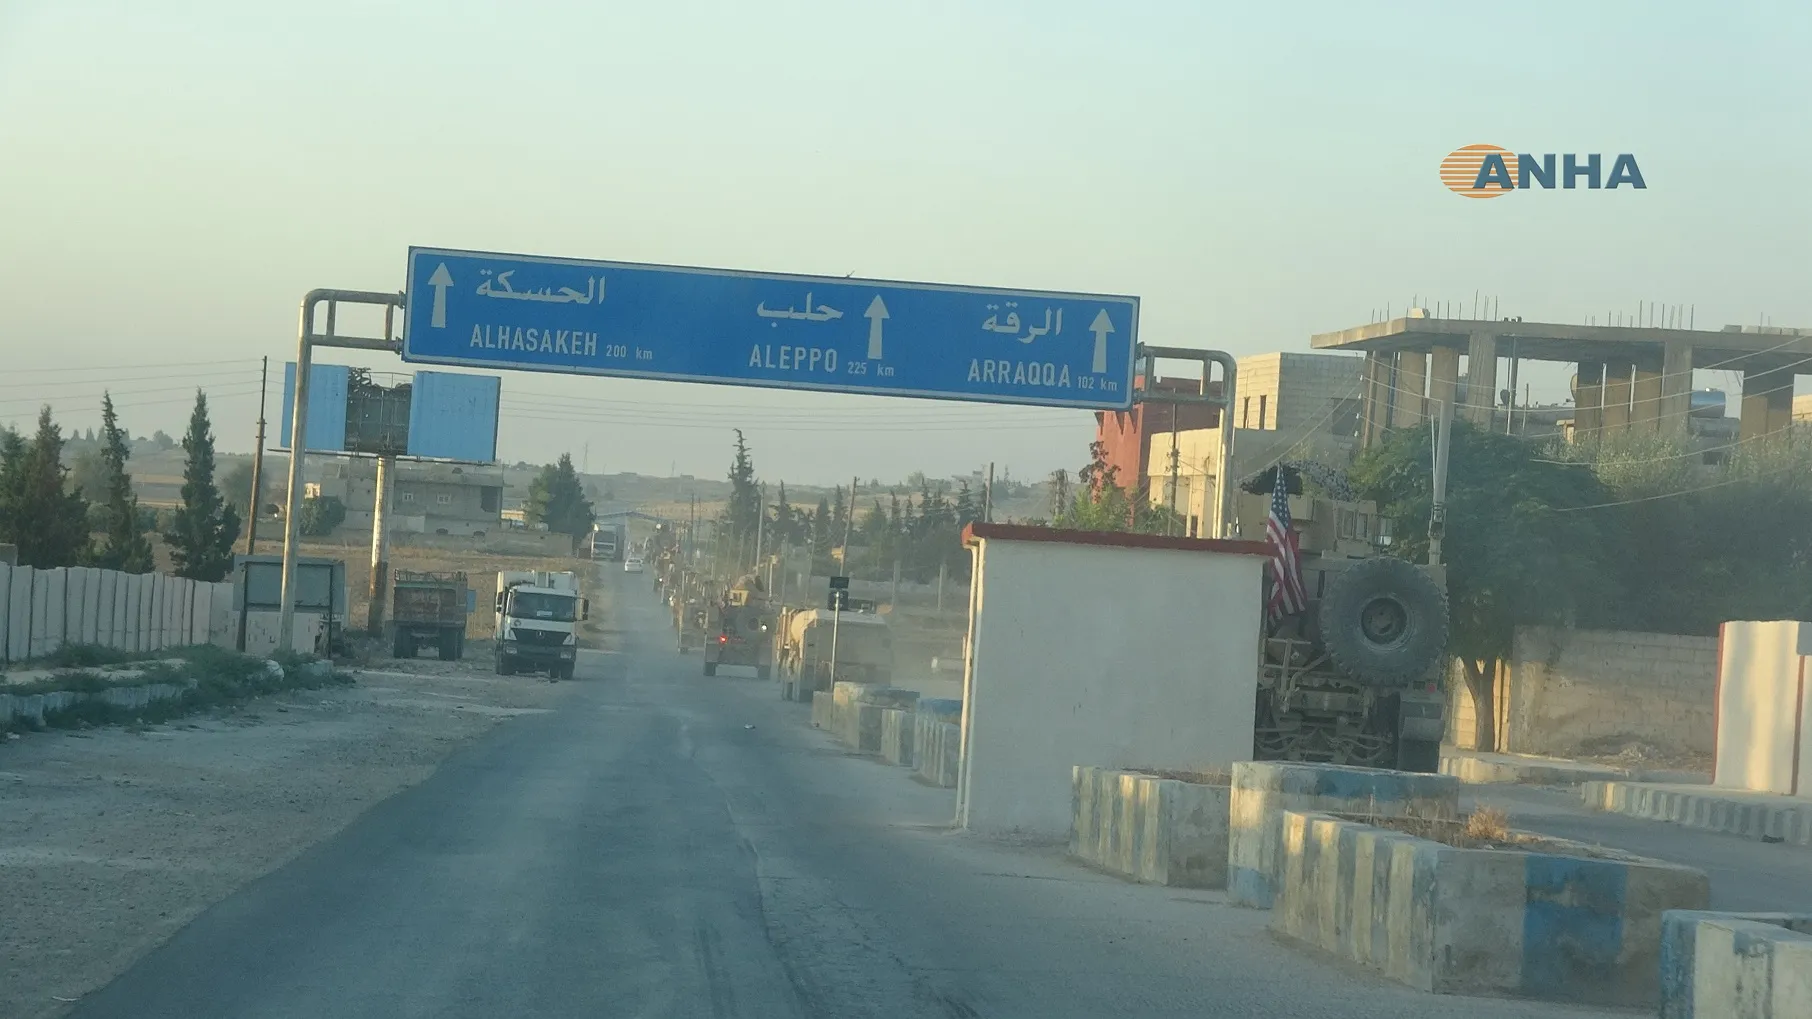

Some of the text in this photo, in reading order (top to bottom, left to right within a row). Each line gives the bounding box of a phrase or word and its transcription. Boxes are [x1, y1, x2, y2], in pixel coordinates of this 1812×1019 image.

[476, 269, 606, 304] الحسكة
[756, 291, 844, 328] حلب
[981, 301, 1063, 344] الرقة
[469, 324, 653, 360] ALHASAKEH 200 km
[749, 344, 894, 377] ALEPPO 225 km
[967, 358, 1118, 391] ARRAQQA 102 km
